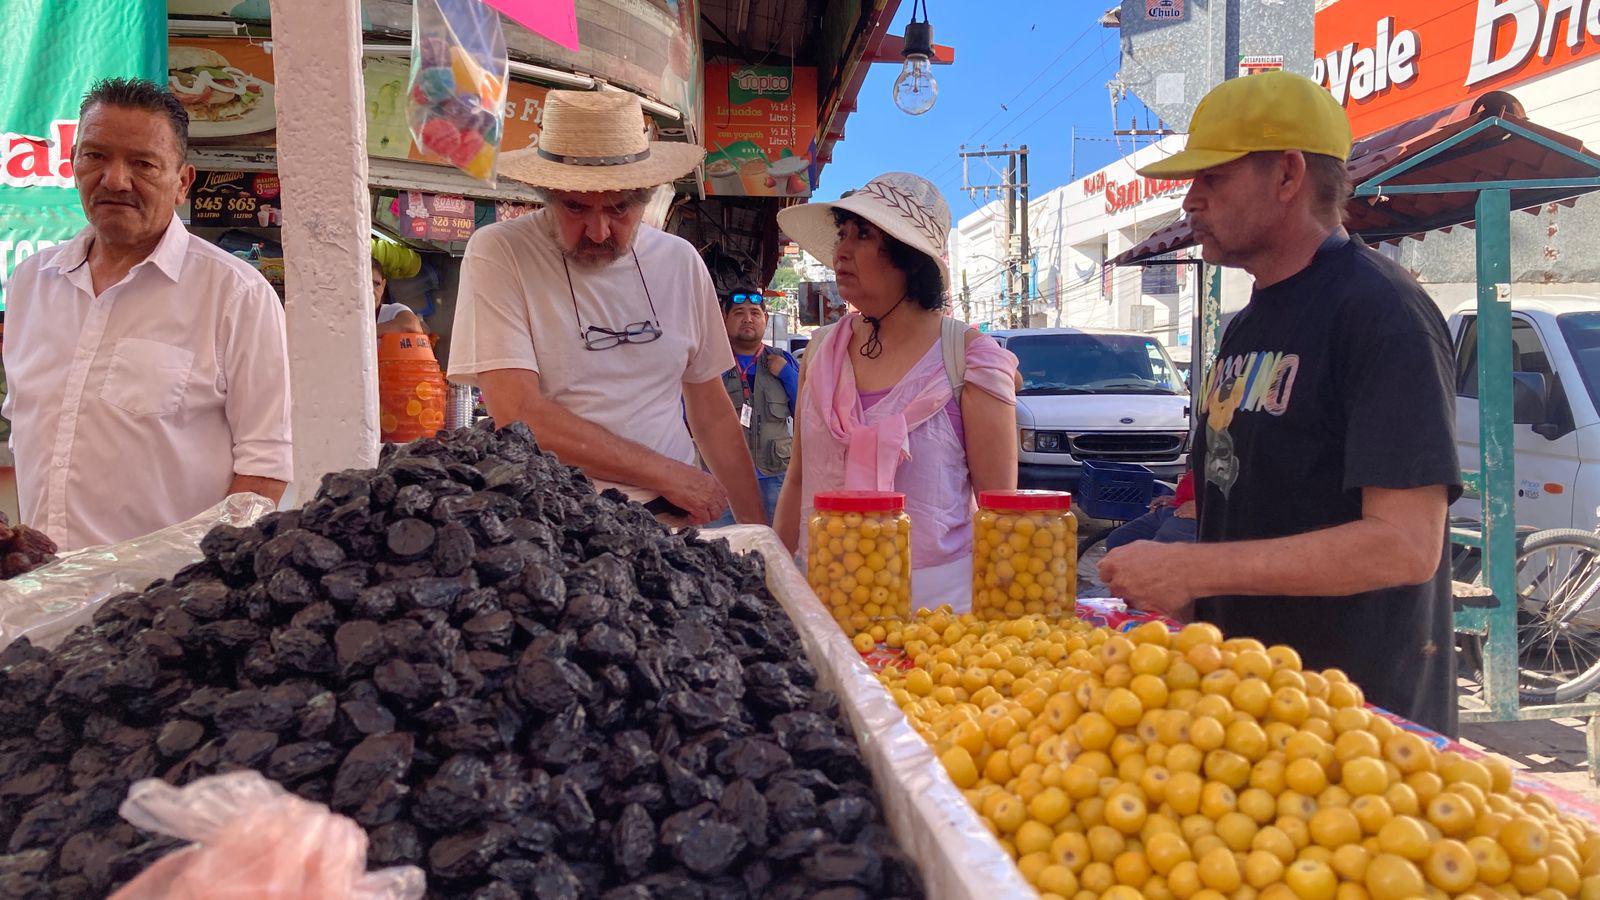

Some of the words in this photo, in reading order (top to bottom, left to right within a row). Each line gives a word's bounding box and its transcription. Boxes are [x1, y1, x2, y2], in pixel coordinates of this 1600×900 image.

[1148, 7, 1180, 17] Chulo
[769, 114, 788, 122] Litro
[769, 137, 788, 145] Litro
[1105, 179, 1140, 213] San
[195, 197, 222, 211] $45
[228, 198, 256, 211] $65
